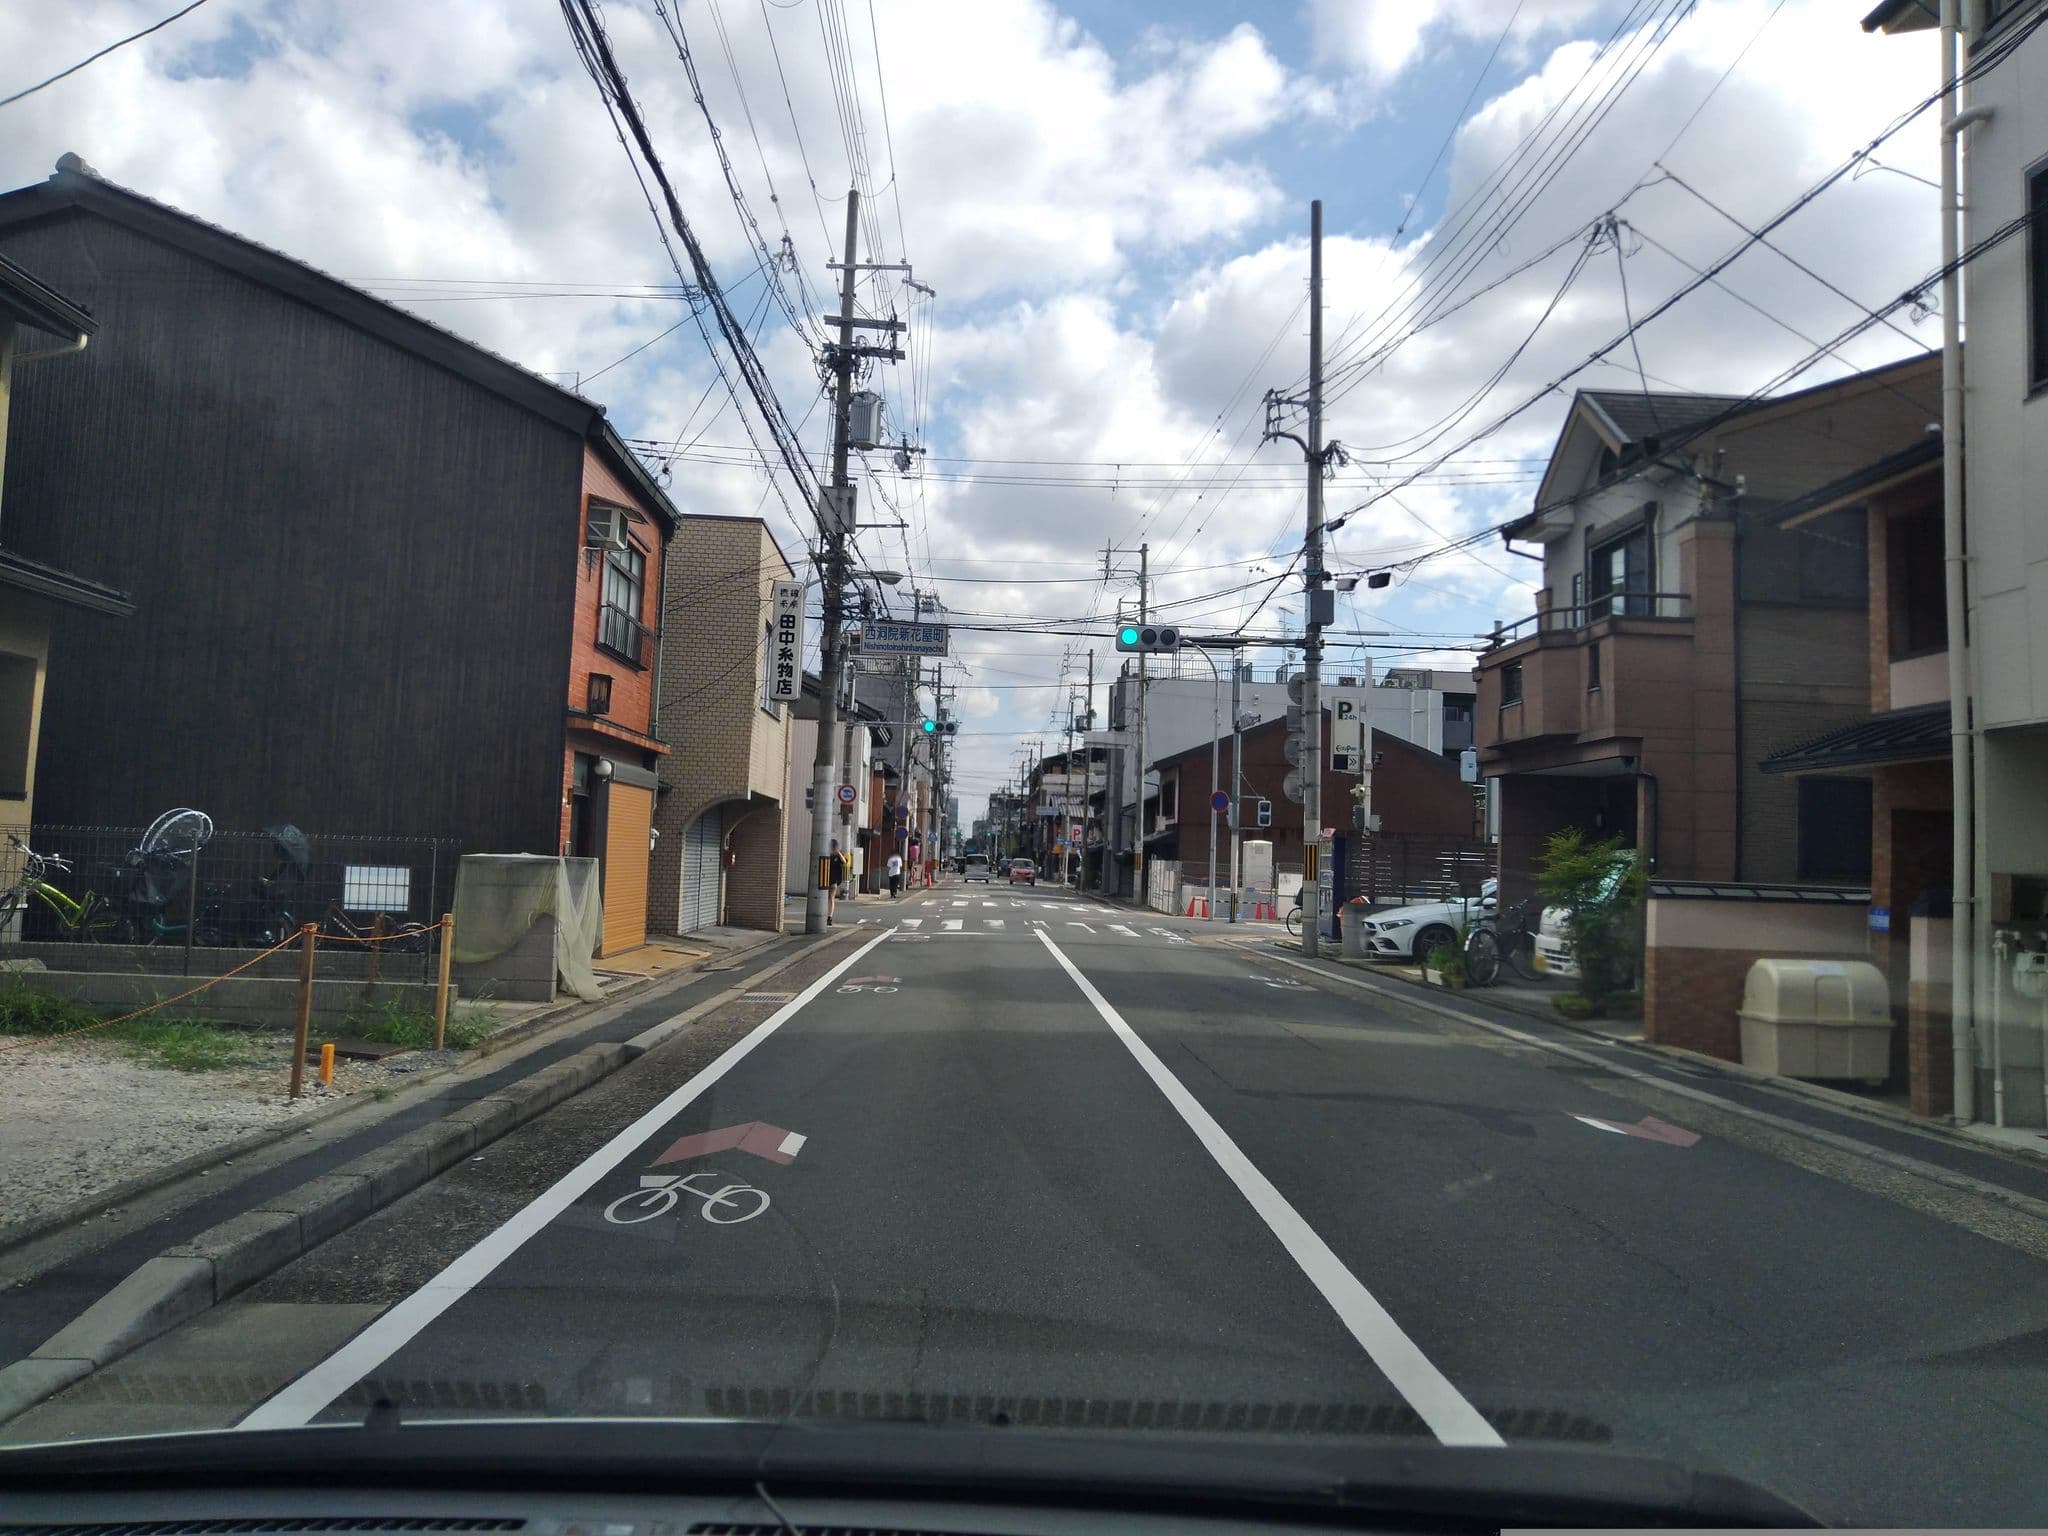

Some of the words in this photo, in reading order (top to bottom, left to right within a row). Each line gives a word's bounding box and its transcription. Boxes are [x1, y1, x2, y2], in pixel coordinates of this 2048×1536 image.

[865, 625, 944, 642] 西洞院新花屋町
[776, 614, 795, 695] 田中糸物店
[1338, 701, 1352, 720] P
[1073, 828, 1081, 840] P
